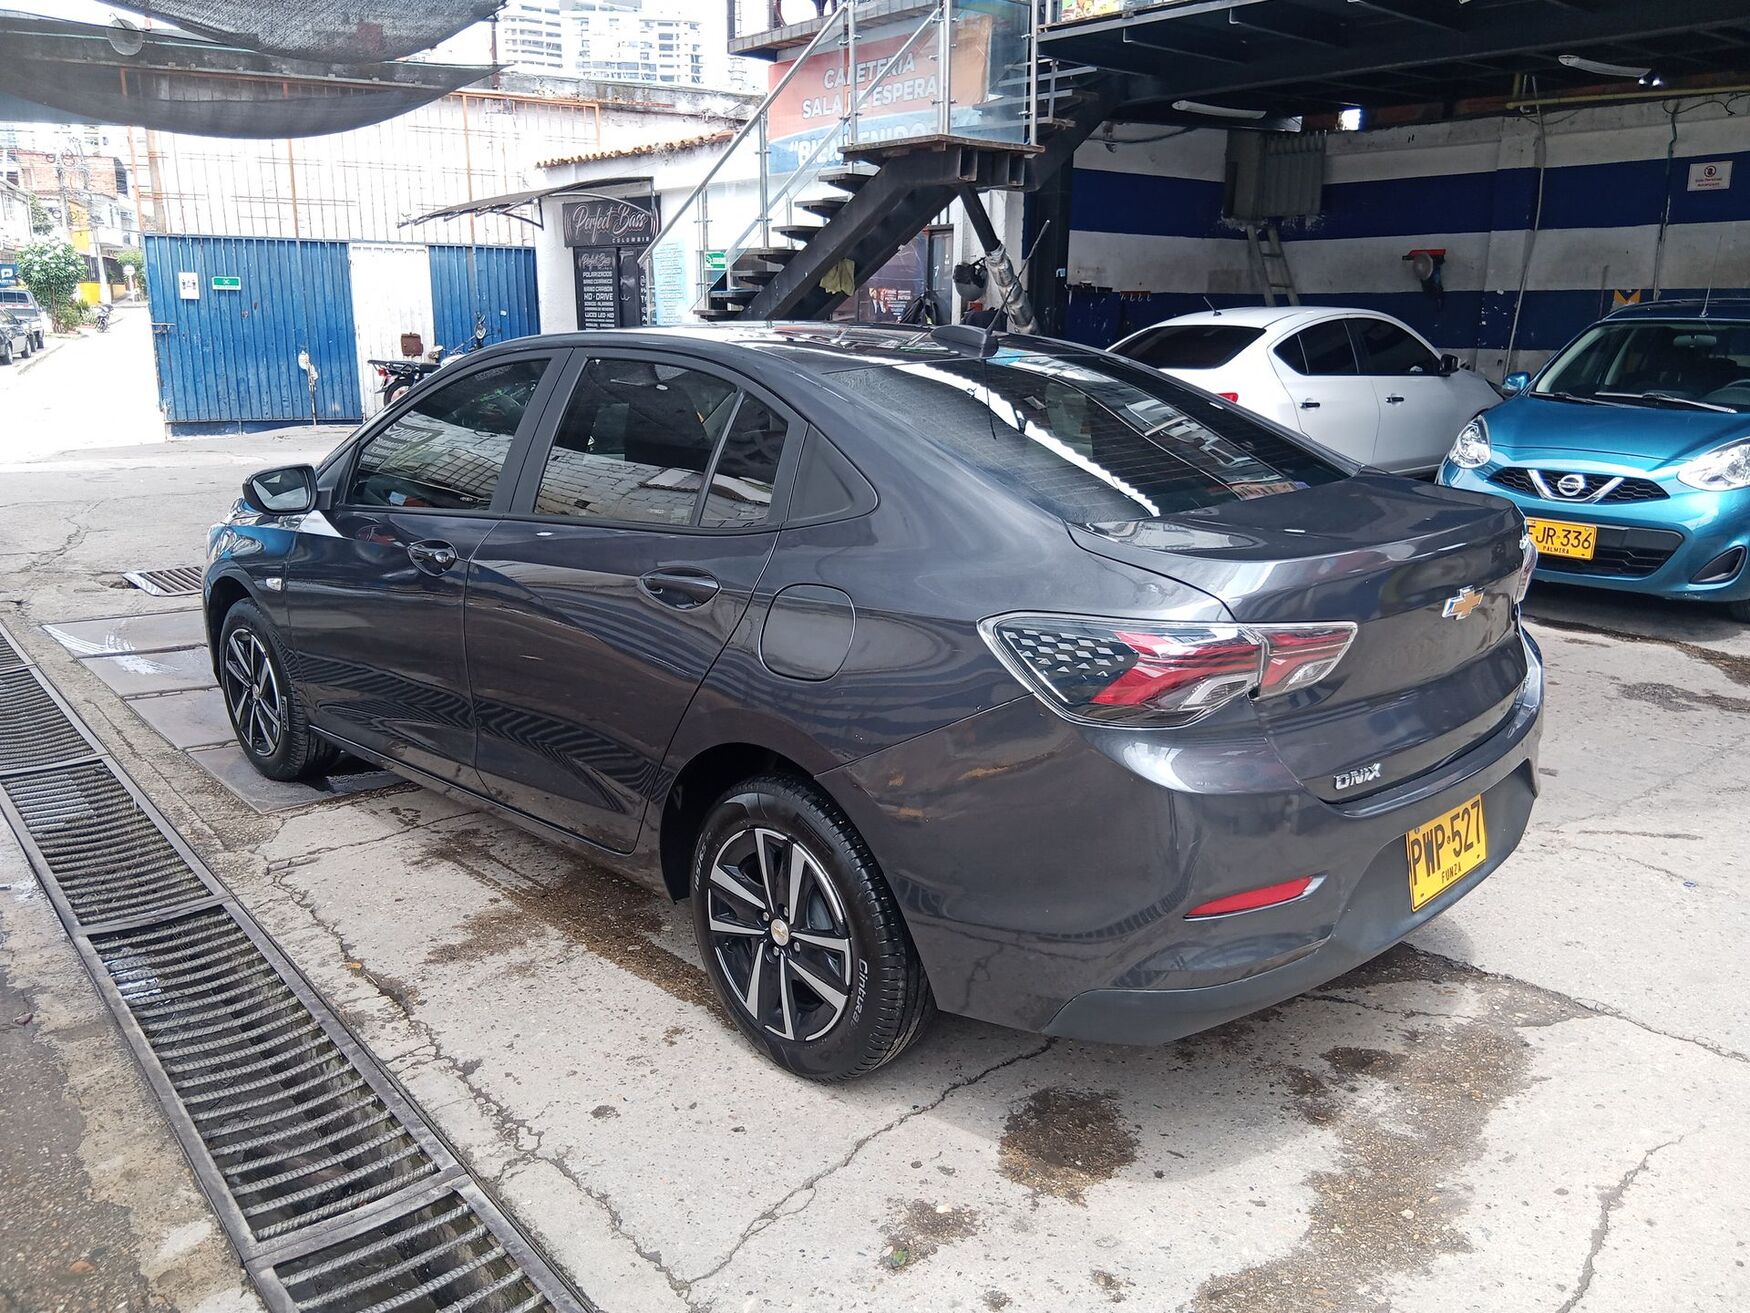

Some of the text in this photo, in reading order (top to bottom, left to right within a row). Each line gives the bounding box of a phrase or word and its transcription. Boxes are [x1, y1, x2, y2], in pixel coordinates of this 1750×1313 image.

[802, 94, 843, 119] SALA
[872, 74, 939, 107] ESPERA
[573, 204, 645, 243] Perfect Bass
[1543, 545, 1569, 554] PALMIRA
[1334, 762, 1381, 790] ONIX
[1441, 862, 1462, 884] FUNZA
